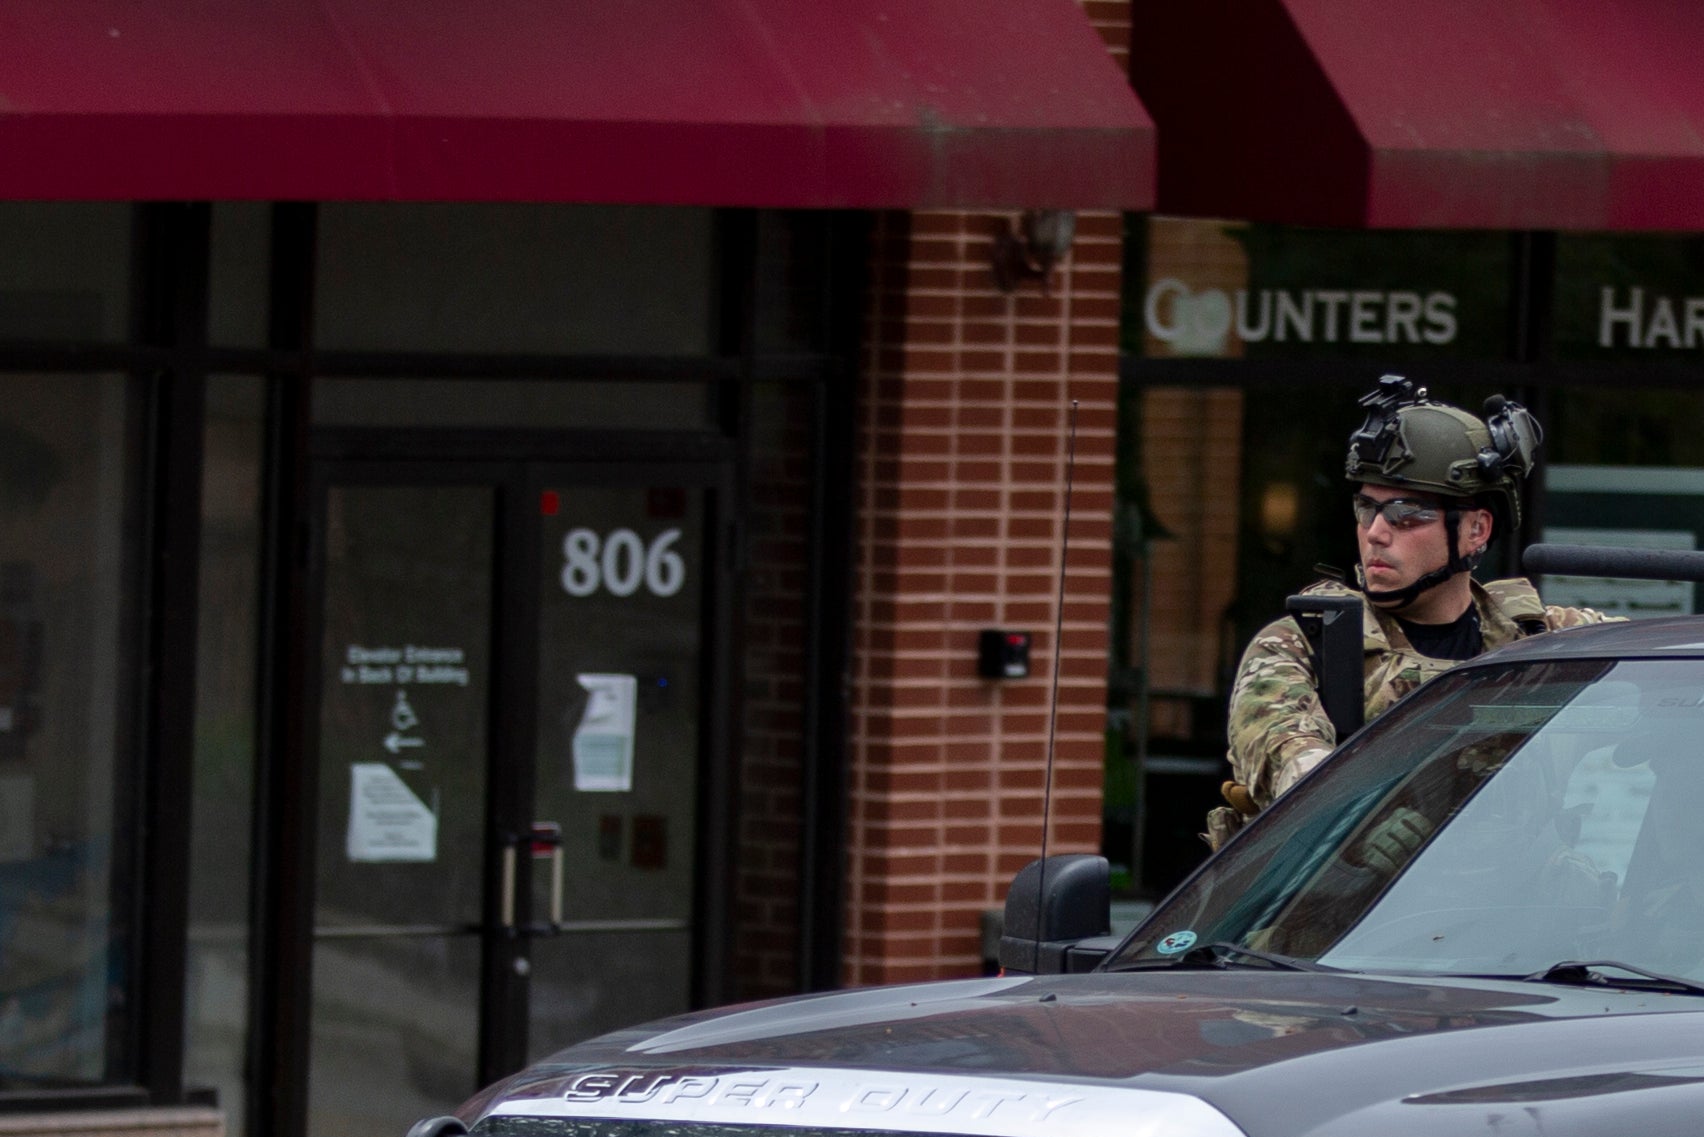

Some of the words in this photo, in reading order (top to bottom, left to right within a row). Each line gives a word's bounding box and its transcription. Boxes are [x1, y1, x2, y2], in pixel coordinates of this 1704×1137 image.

[1143, 278, 1458, 345] COUNTERS
[561, 527, 686, 597] 806
[564, 1073, 821, 1110] SUPER
[838, 1084, 1087, 1123] DUTY
